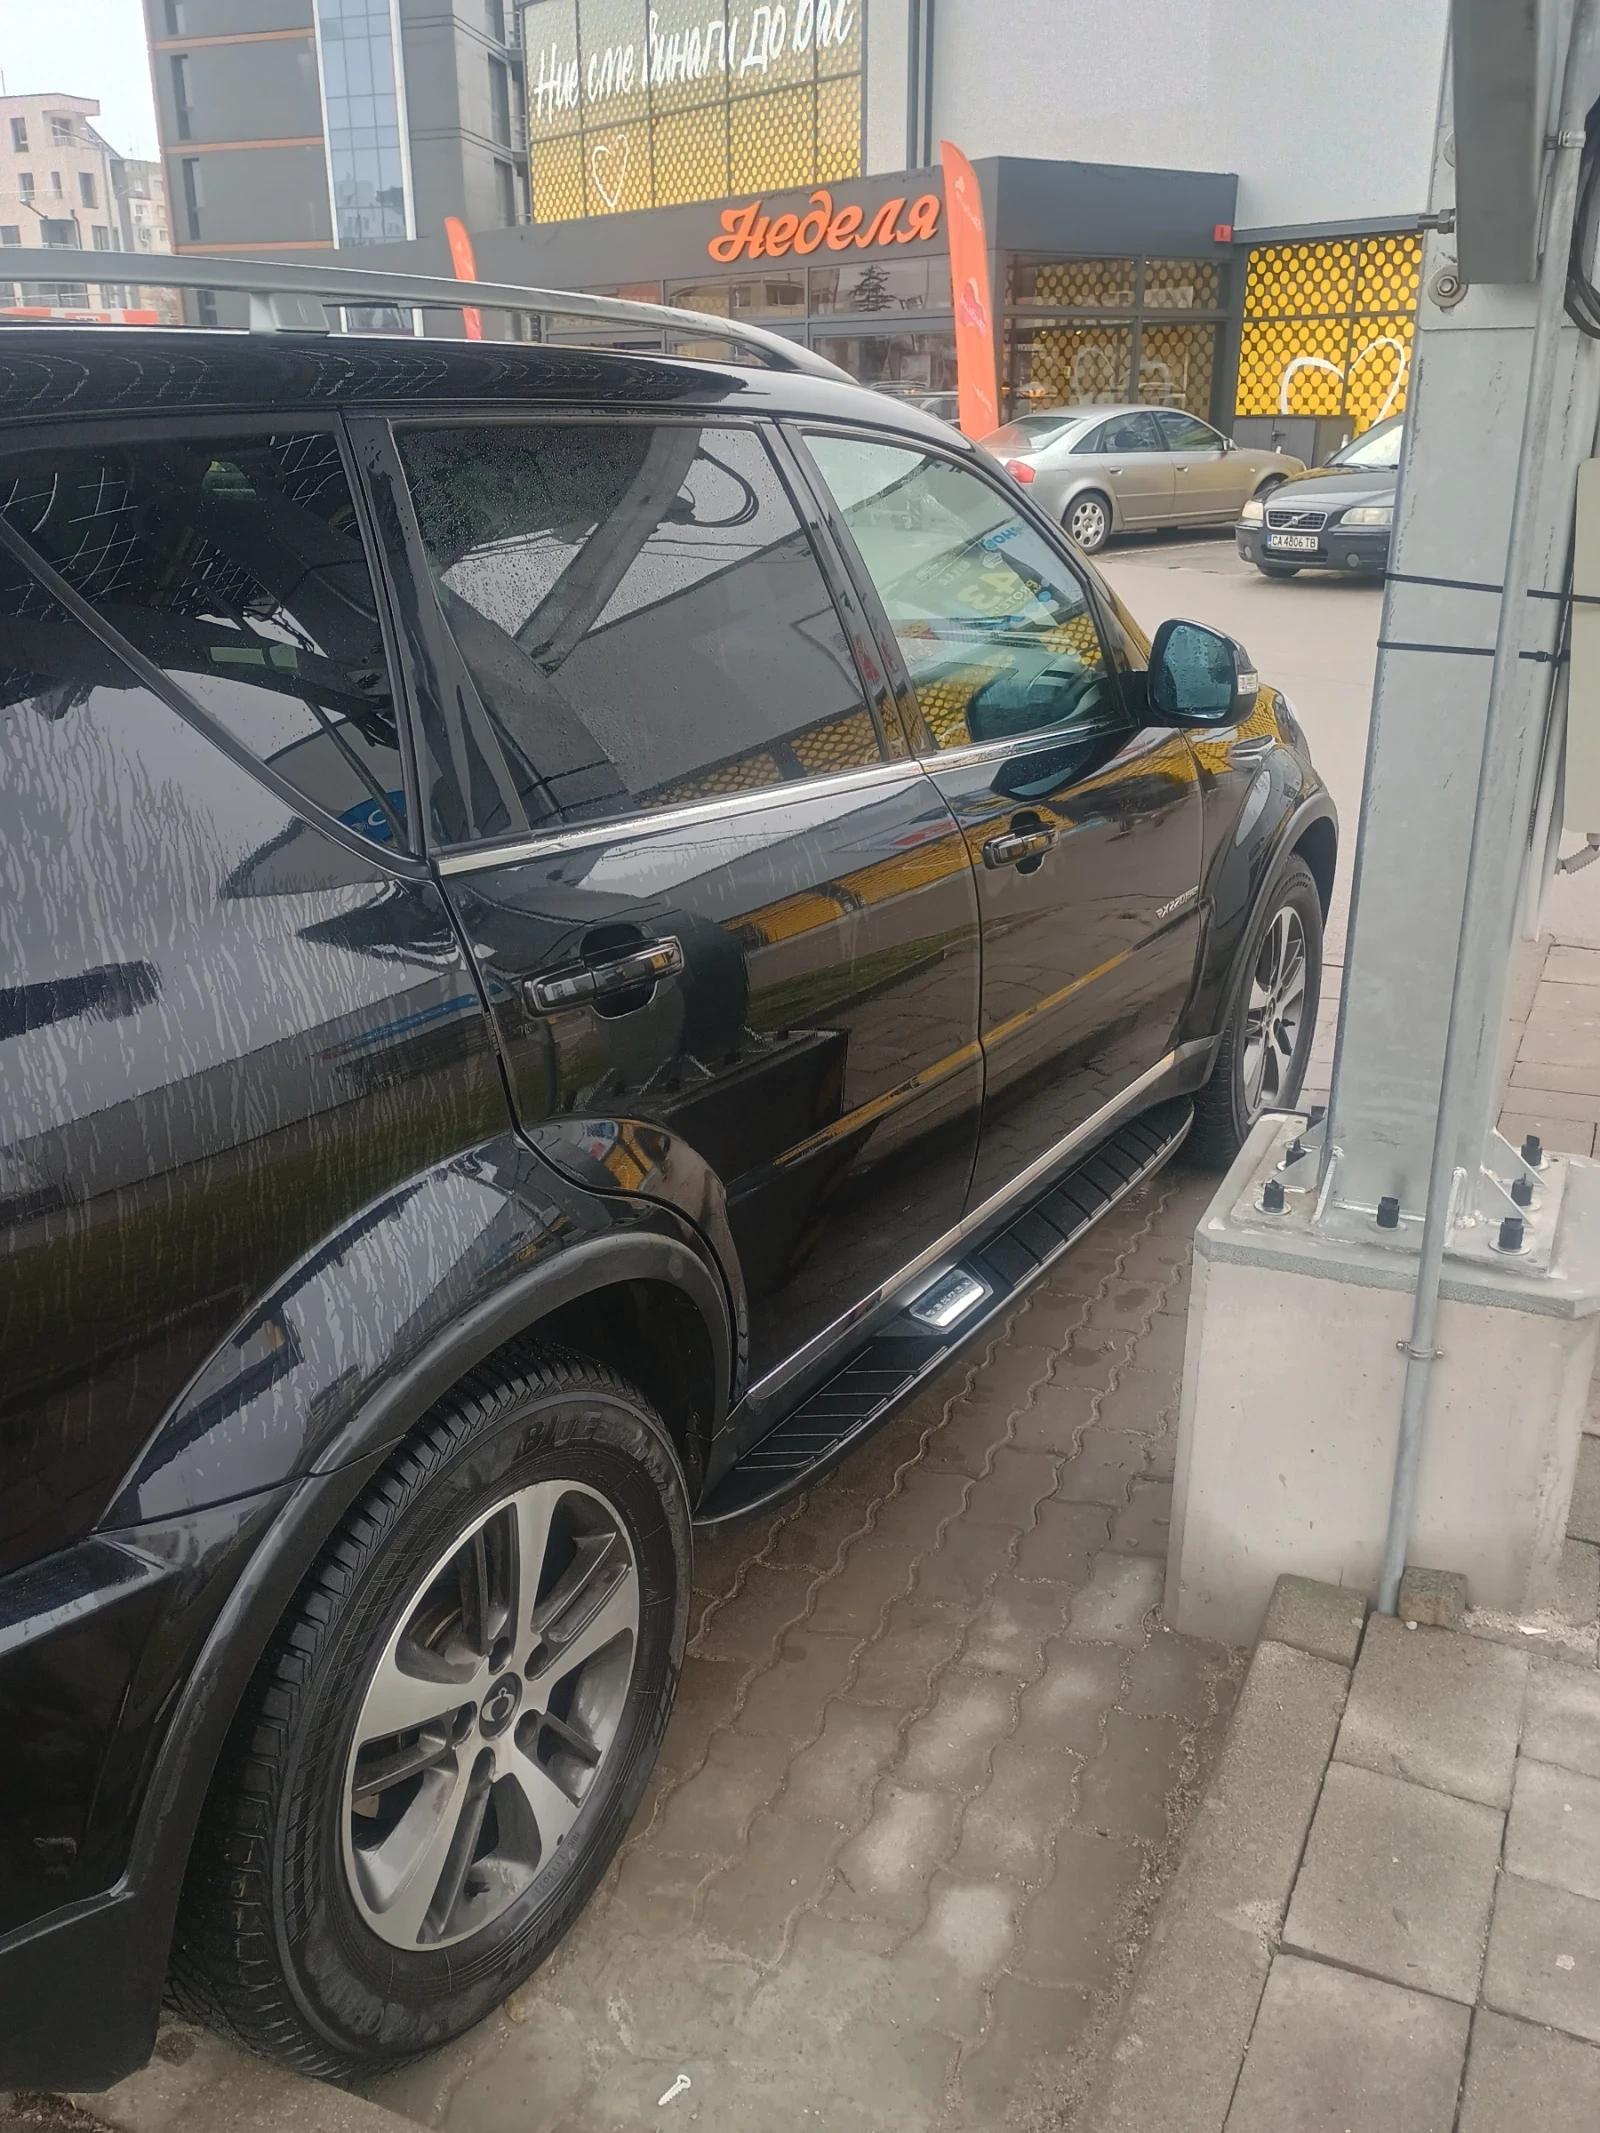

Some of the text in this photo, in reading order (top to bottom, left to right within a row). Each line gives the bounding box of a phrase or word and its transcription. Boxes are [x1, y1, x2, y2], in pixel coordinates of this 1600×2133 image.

[534, 42, 579, 123] Ние
[708, 189, 941, 262] Неделя
[1272, 535, 1317, 549] CA 4806 TB
